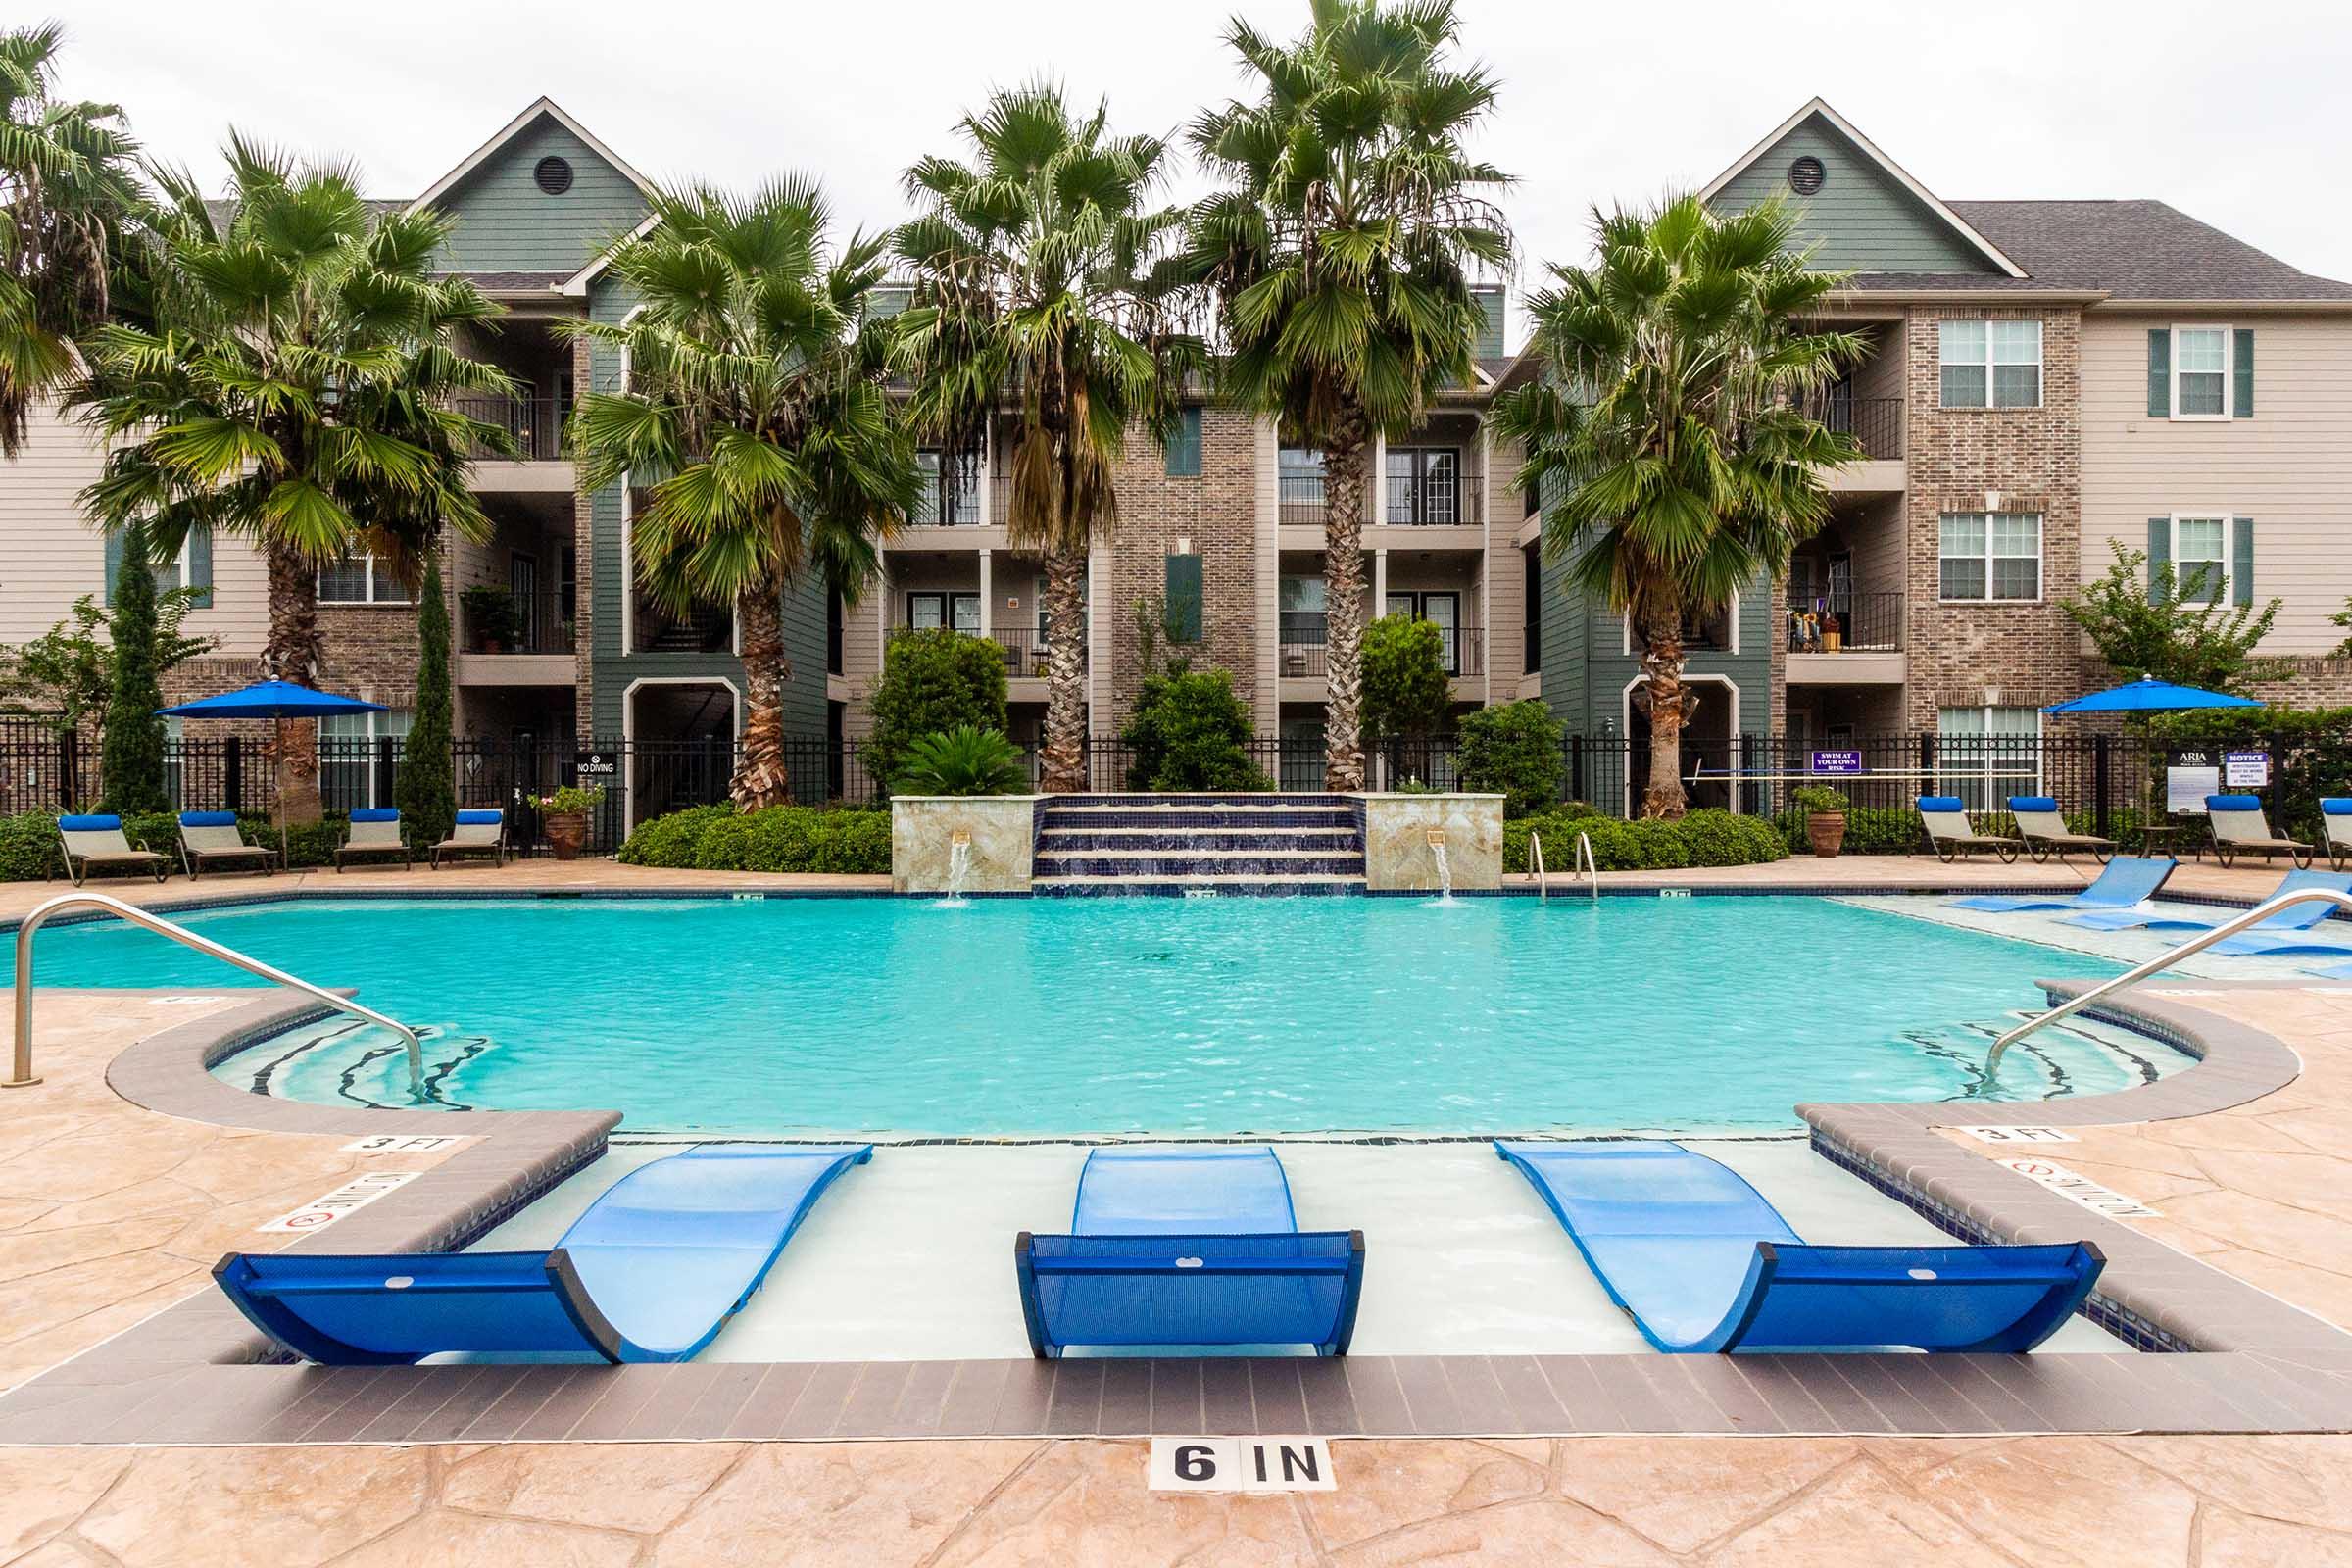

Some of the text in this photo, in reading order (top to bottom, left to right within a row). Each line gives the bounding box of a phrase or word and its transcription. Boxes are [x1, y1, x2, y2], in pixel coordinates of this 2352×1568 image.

[2180, 753, 2207, 761] ARIA
[577, 763, 613, 772] NO DIVING
[1978, 1128, 2063, 1140] 3 FT
[362, 1138, 457, 1149] 3 FT
[1175, 1445, 1320, 1482] 6 IN
